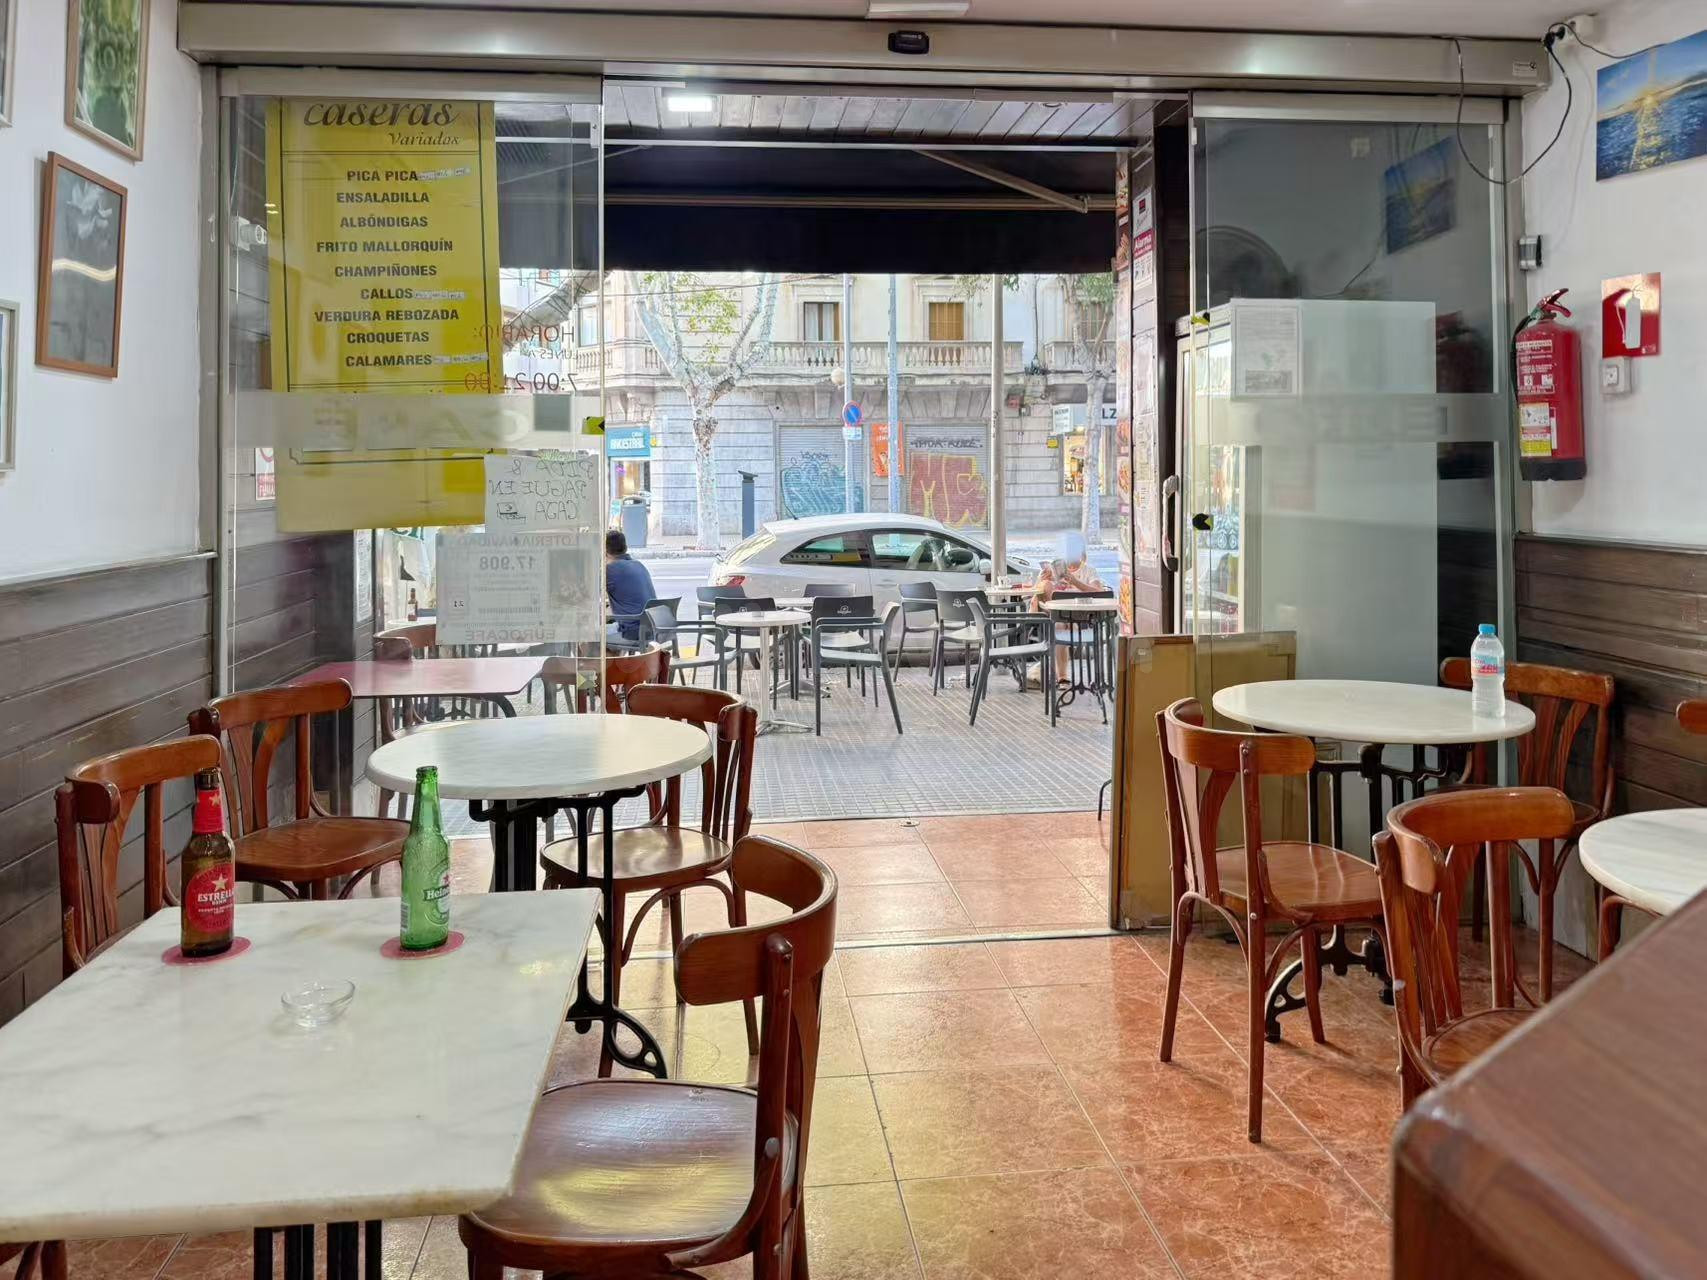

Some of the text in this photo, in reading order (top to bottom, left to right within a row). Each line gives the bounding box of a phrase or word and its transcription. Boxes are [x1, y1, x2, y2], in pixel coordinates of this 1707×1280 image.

[304, 102, 459, 126] caseras
[346, 170, 380, 182] PICA
[385, 169, 418, 181] PICA
[336, 191, 430, 204] ENSALADILLA
[340, 212, 428, 228] ALBÓNDIGAS
[316, 237, 453, 253] FRITO MALLORQUÍN
[334, 263, 437, 277] CHAMPIÑONES
[360, 288, 413, 300] CALLOS
[314, 308, 459, 322] VERDURA REBOZADA
[346, 331, 429, 344] CROQUETAS
[345, 354, 433, 367] CALAMARES
